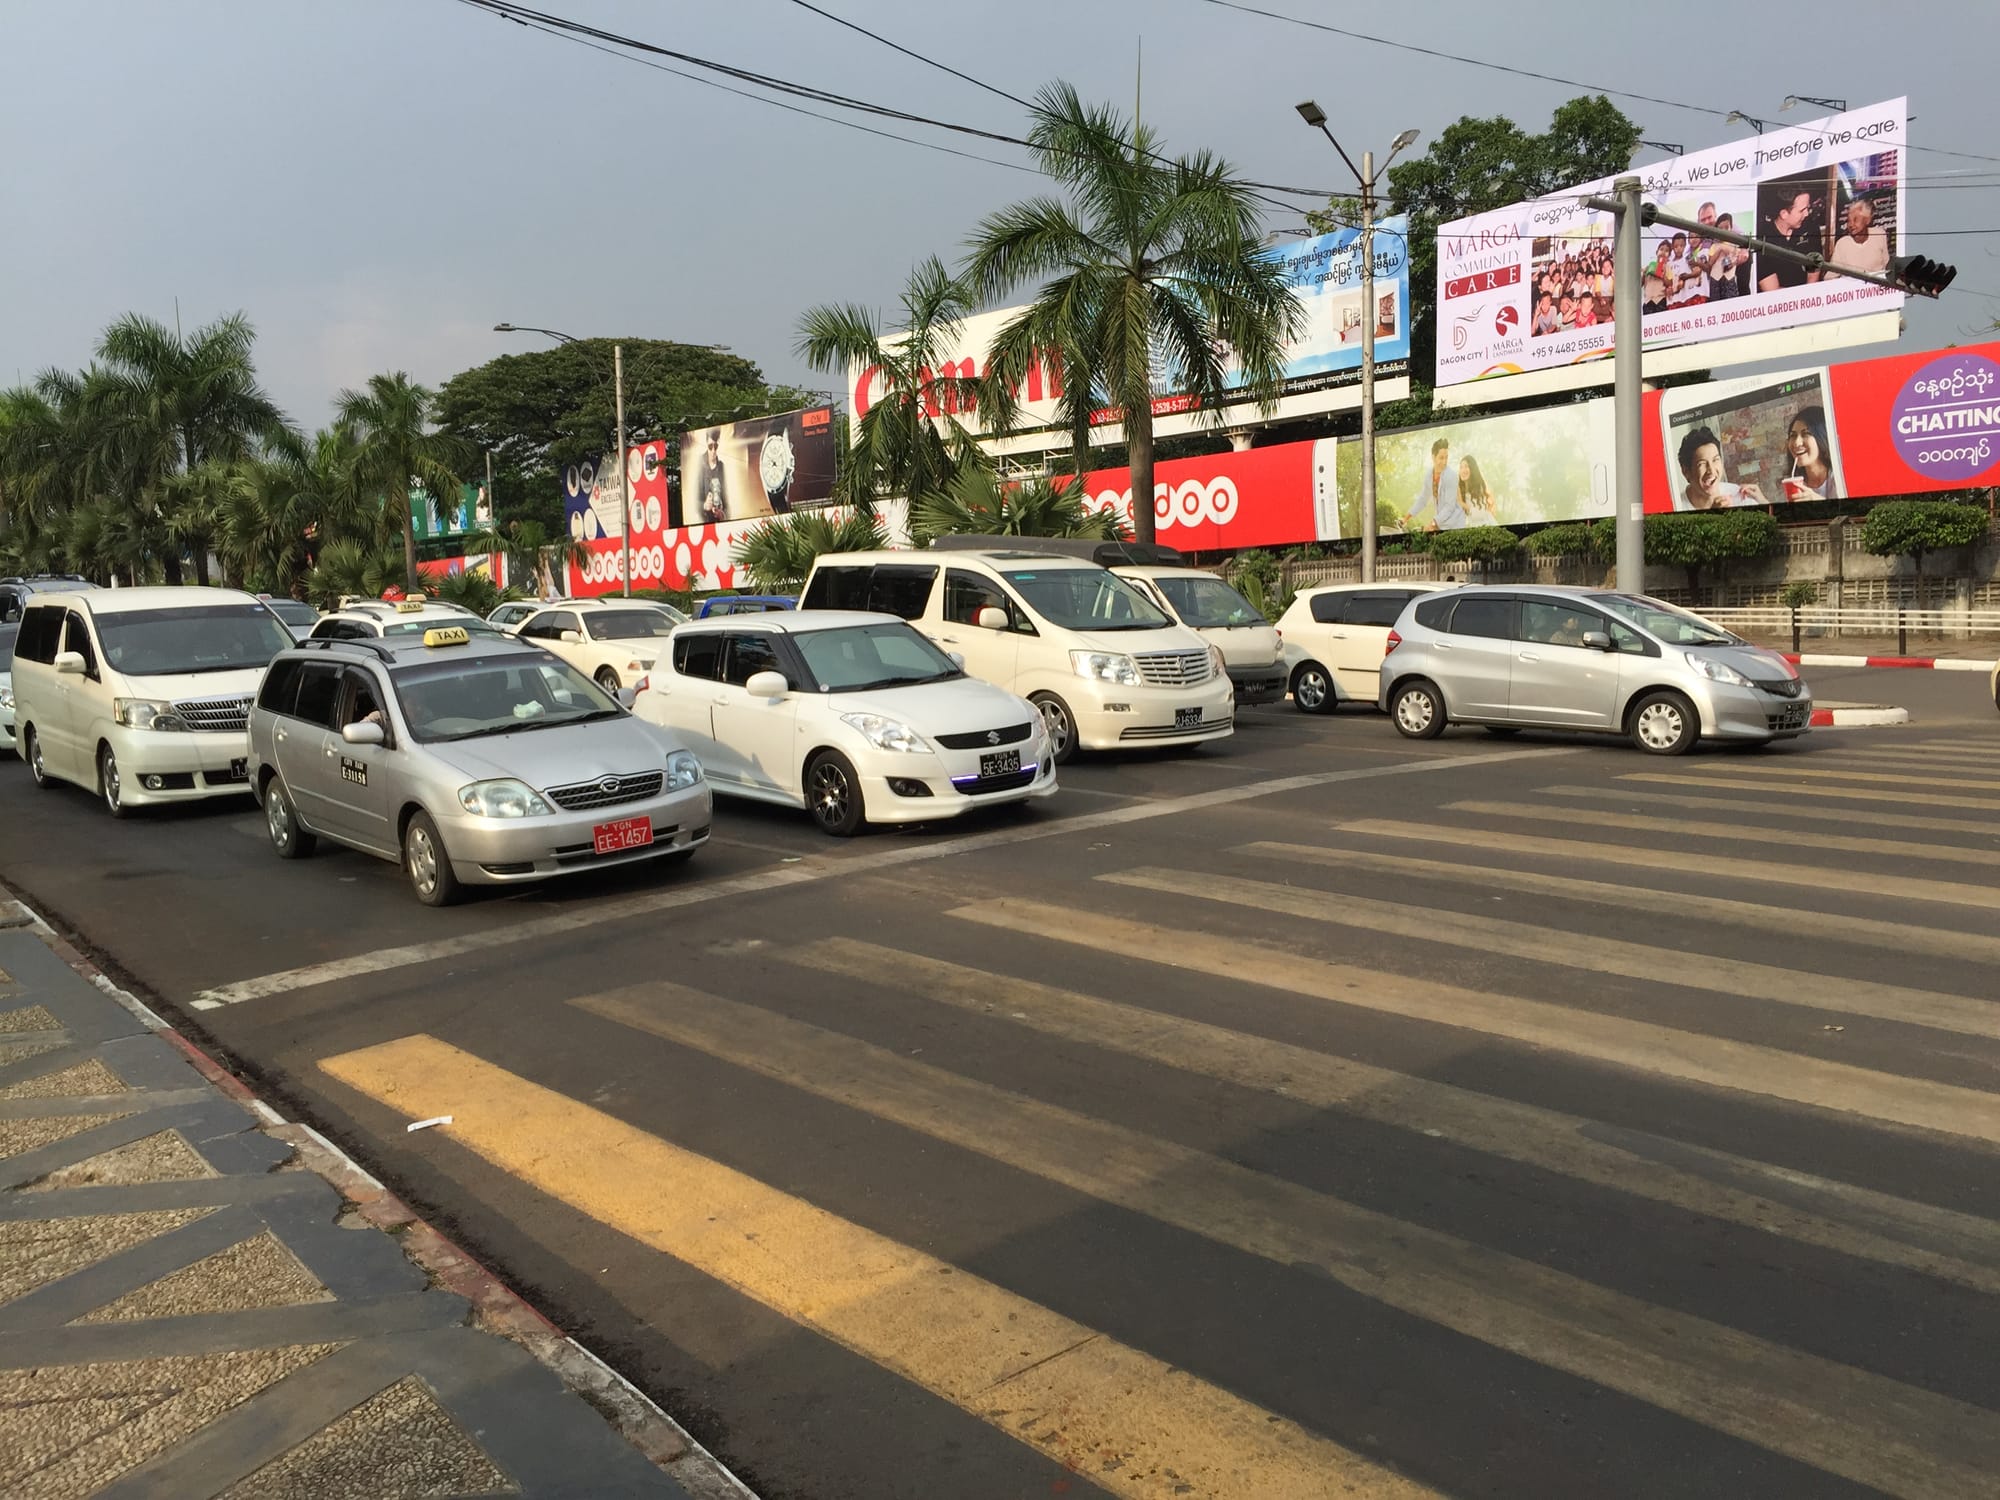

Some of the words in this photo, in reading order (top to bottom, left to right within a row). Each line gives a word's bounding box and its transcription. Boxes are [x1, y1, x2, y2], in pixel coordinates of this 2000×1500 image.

[1687, 166, 1709, 183] We
[1713, 156, 1749, 176] Love.
[1754, 136, 1824, 166] Therefore
[1828, 130, 1852, 147] we
[1856, 118, 1899, 140] care.
[1446, 222, 1520, 260] MARGA
[1445, 249, 1520, 279] COMMUNITY
[1447, 266, 1518, 298] CARE
[1643, 327, 1653, 337] BO
[1721, 307, 1766, 324] ZOOLOGICAL
[1767, 300, 1799, 315] GARDEN
[1800, 296, 1825, 310] ROAD,
[1826, 290, 1854, 305] DAGON
[1492, 337, 1524, 352] MARGA
[1531, 346, 1547, 359] +95
[1555, 341, 1577, 355] 4482
[1578, 335, 1605, 350] 55555
[1440, 355, 1467, 366] DAGON
[1467, 351, 1483, 361] CITY
[435, 629, 466, 641] TAXI
[983, 757, 1020, 776] 5E-3435
[613, 821, 632, 831] YGN
[597, 826, 648, 851] EE-1457
